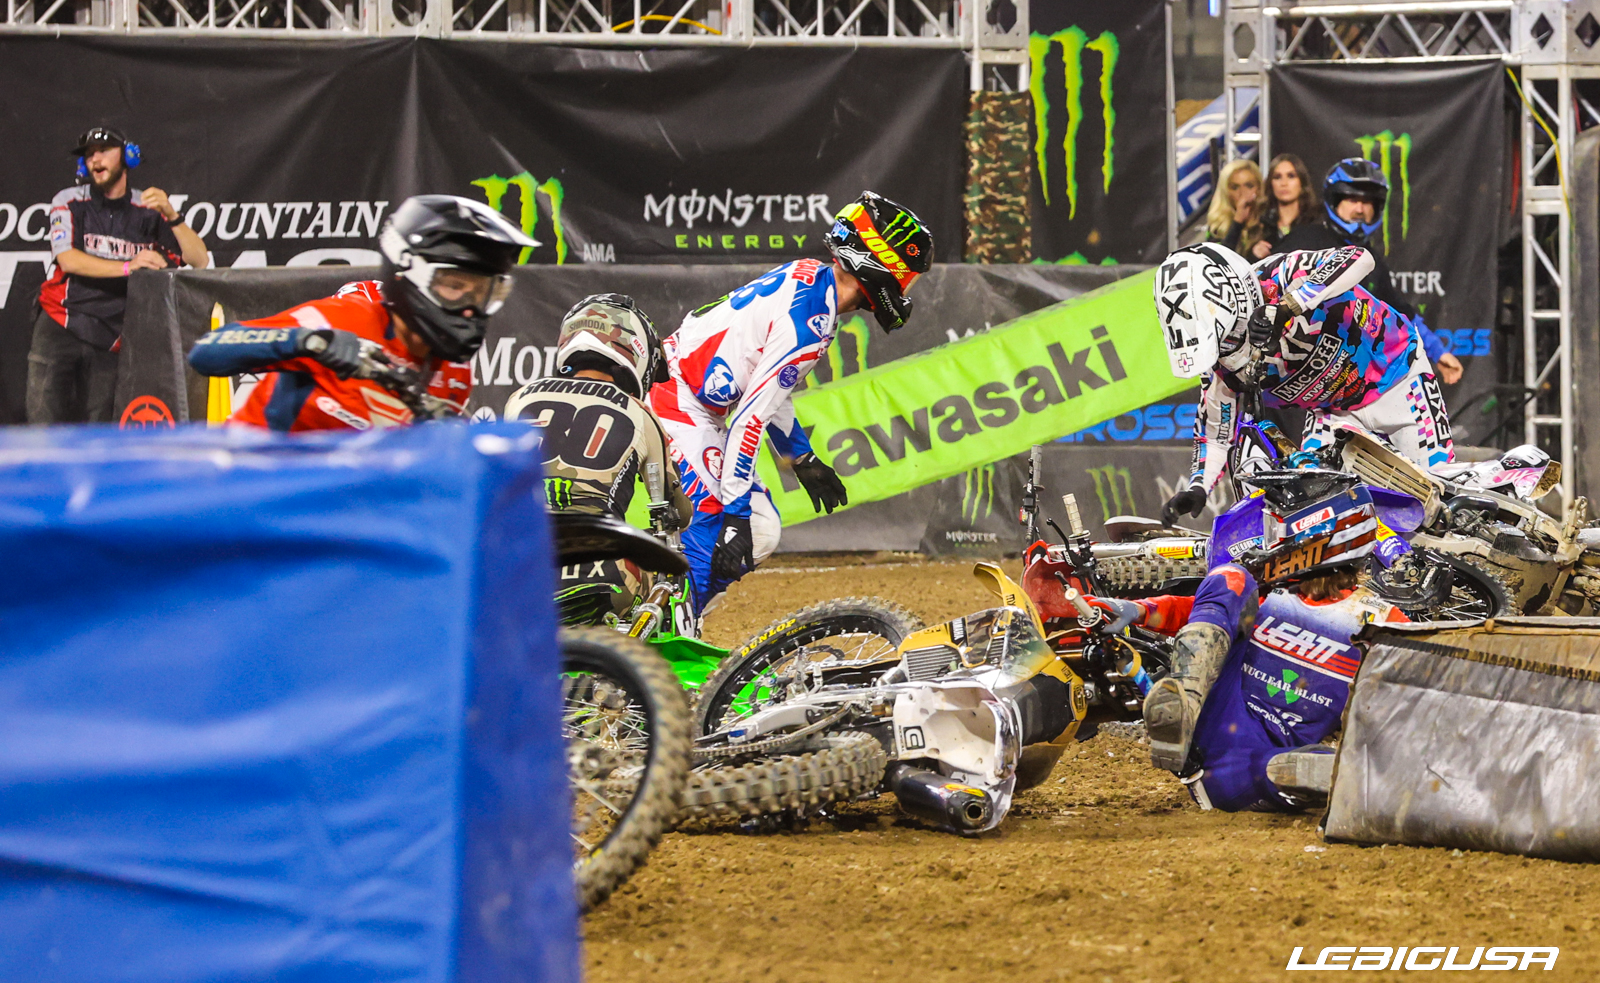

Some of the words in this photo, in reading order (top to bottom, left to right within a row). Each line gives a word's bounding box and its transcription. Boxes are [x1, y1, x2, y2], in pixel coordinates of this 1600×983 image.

[166, 194, 388, 241] OUNTAIN
[583, 244, 616, 263] AMA
[675, 234, 807, 249] ENERGY
[791, 258, 821, 286] RAIG
[568, 319, 606, 333] SHIMODA
[632, 338, 647, 358] BELL
[518, 380, 630, 410] SHIMODA
[1229, 536, 1264, 558] CLUBM
[741, 618, 797, 658] DUNLOP
[1253, 615, 1352, 665] LEATT
[1240, 662, 1292, 693] NUCLEAR
[1293, 683, 1334, 708] BLAST
